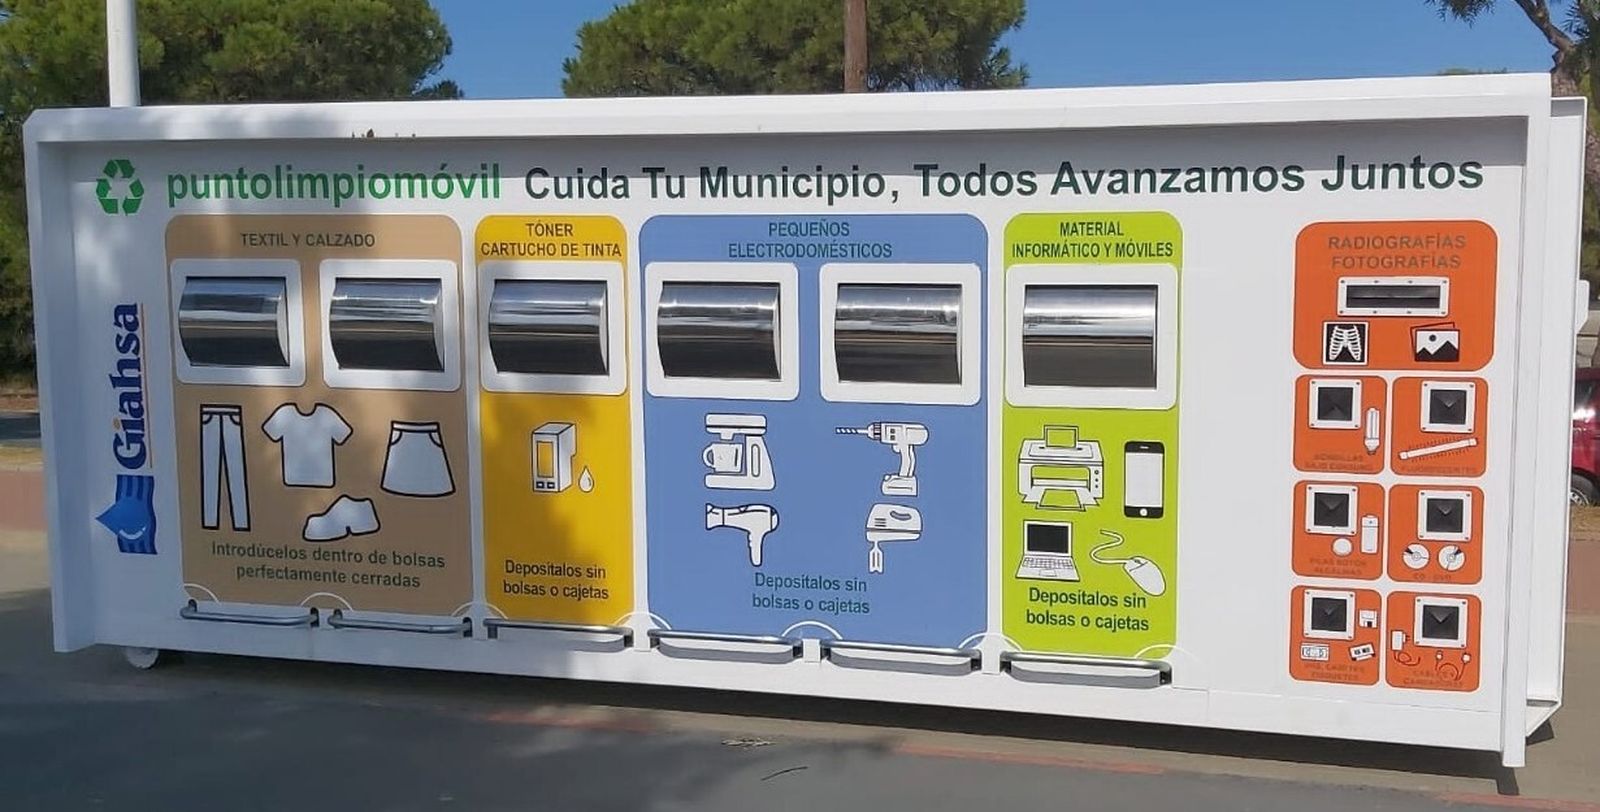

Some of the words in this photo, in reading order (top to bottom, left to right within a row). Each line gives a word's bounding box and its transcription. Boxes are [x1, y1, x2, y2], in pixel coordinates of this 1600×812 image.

[166, 163, 502, 206] puntolimpiomóvil
[525, 167, 630, 199] Cuida
[642, 166, 686, 198] Tu
[913, 163, 1038, 197] Todos
[1050, 161, 1305, 195] Avanzamos
[1321, 155, 1484, 191] Juntos
[525, 222, 574, 237] TÓNER
[768, 220, 850, 238] PEQUEÑOS
[1060, 222, 1124, 237] MATERIAL
[241, 233, 289, 247] TEXTIL
[292, 233, 301, 247] Y
[305, 233, 376, 248] CALZADO
[480, 242, 556, 257] CARTUCHO
[560, 243, 579, 257] DE
[583, 243, 622, 257] TINTA
[728, 239, 893, 259] ELECTRODOMÉSTICOS
[1012, 240, 1100, 258] INFORMÁTICO
[1103, 242, 1113, 257] Y
[1115, 239, 1174, 258] MÓVILES
[1327, 233, 1466, 250] RADIOGRAFÍAS
[1331, 253, 1462, 270] FOTOGRAFÍAS
[109, 303, 147, 470] Giahsa
[211, 541, 308, 560] Introdúcelos
[312, 547, 363, 563] dentro
[368, 550, 387, 565] de
[392, 551, 446, 568] bolsas
[236, 565, 347, 583] perfectamente
[351, 572, 421, 588] cerradas
[586, 565, 607, 579] sin
[503, 579, 547, 597] bolsas
[550, 586, 559, 597] o
[563, 584, 610, 602] cajetas
[845, 577, 867, 592] sin
[752, 593, 801, 610] bolsas
[805, 600, 814, 610] o
[819, 597, 870, 616] cajetas
[1123, 593, 1147, 608] sin
[1026, 609, 1076, 627] bolsas
[1081, 616, 1091, 627] o
[1095, 614, 1149, 633] cajetas
